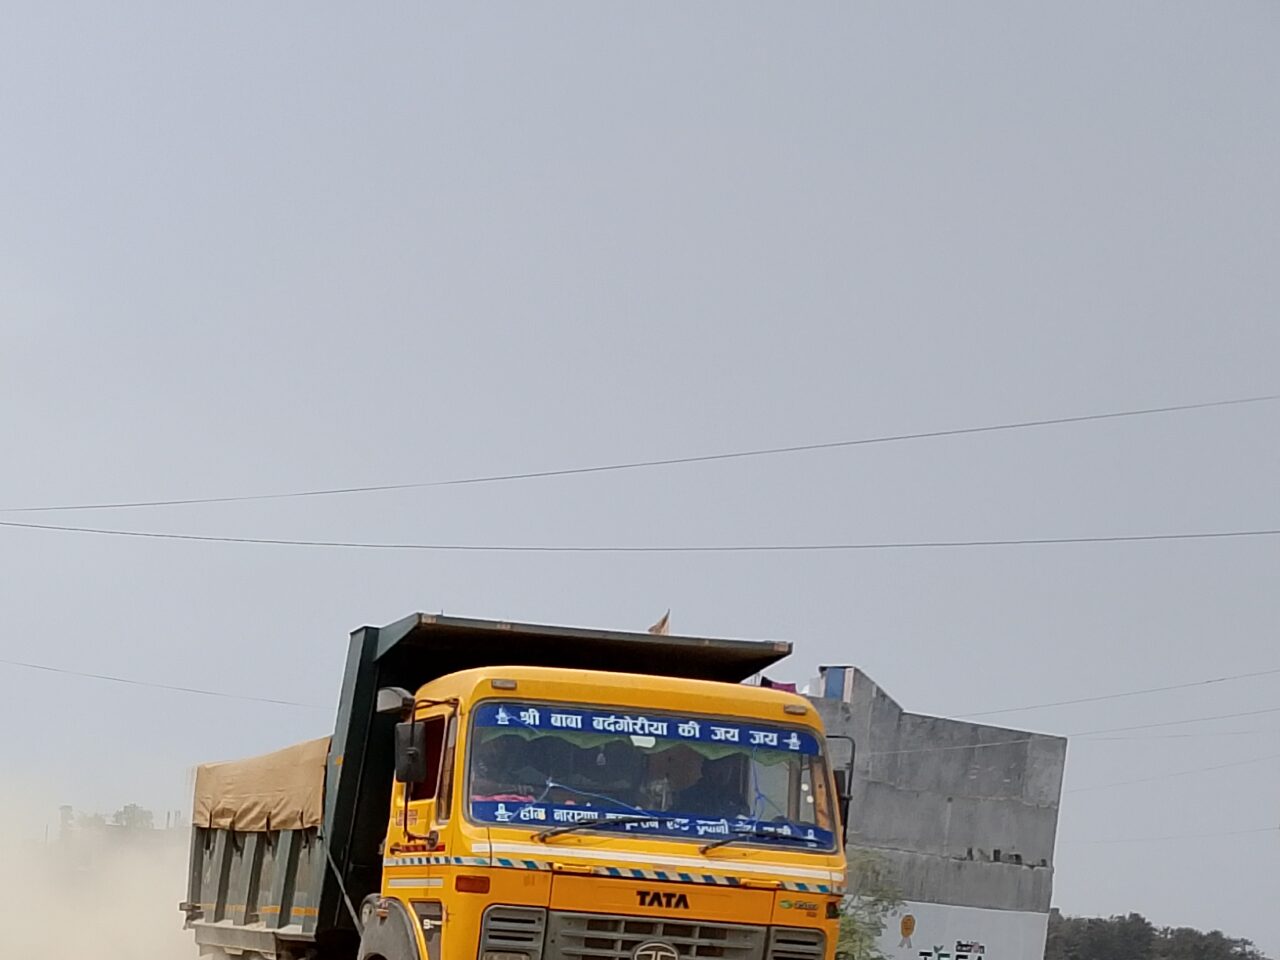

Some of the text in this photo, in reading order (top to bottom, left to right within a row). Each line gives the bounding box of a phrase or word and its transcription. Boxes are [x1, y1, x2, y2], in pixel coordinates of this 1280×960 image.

[520, 708, 540, 726] श्री
[550, 713, 582, 729] बाबा
[678, 720, 700, 738] की
[710, 726, 740, 742] जय
[749, 730, 778, 746] जय
[637, 891, 689, 909] TATA
